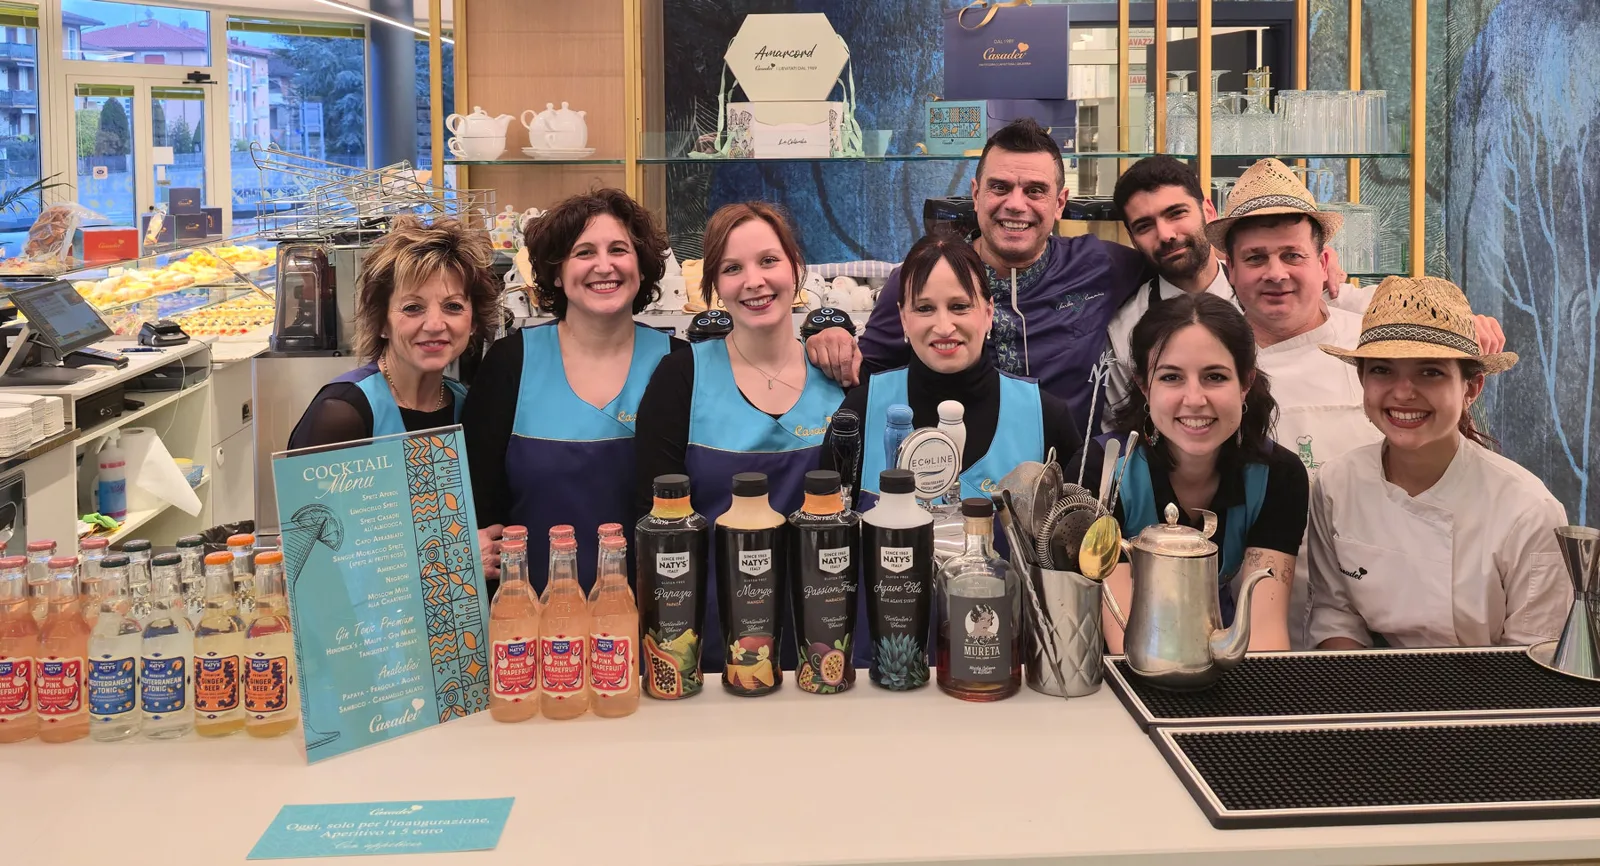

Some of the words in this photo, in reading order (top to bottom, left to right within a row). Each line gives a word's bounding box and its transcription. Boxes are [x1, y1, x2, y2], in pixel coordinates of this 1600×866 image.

[754, 44, 818, 60] Amarcord
[982, 47, 1024, 60] Casadei
[795, 423, 827, 438] Casad
[303, 455, 393, 481] COCKTAIL
[314, 473, 374, 500] Menu
[659, 560, 687, 569] NATY'S
[742, 558, 769, 566] NATY'S
[822, 556, 848, 565] NATY'S
[737, 584, 773, 600] Mango
[804, 585, 840, 599] Passion
[874, 580, 903, 597] Agave
[903, 581, 922, 594] Blu
[654, 588, 692, 606] Papaya
[964, 646, 1000, 656] MURETA
[500, 665, 534, 676] GRAPEFRUIT
[544, 664, 578, 673] GRAPEFRUIT
[592, 663, 623, 672] GRAPEFRUIT
[369, 708, 421, 734] Casadei
[286, 822, 321, 832] Oggi,
[326, 821, 354, 829] solo
[358, 820, 382, 830] per
[384, 817, 490, 828] l'inaugurazione,
[320, 829, 384, 839] Aperitivo
